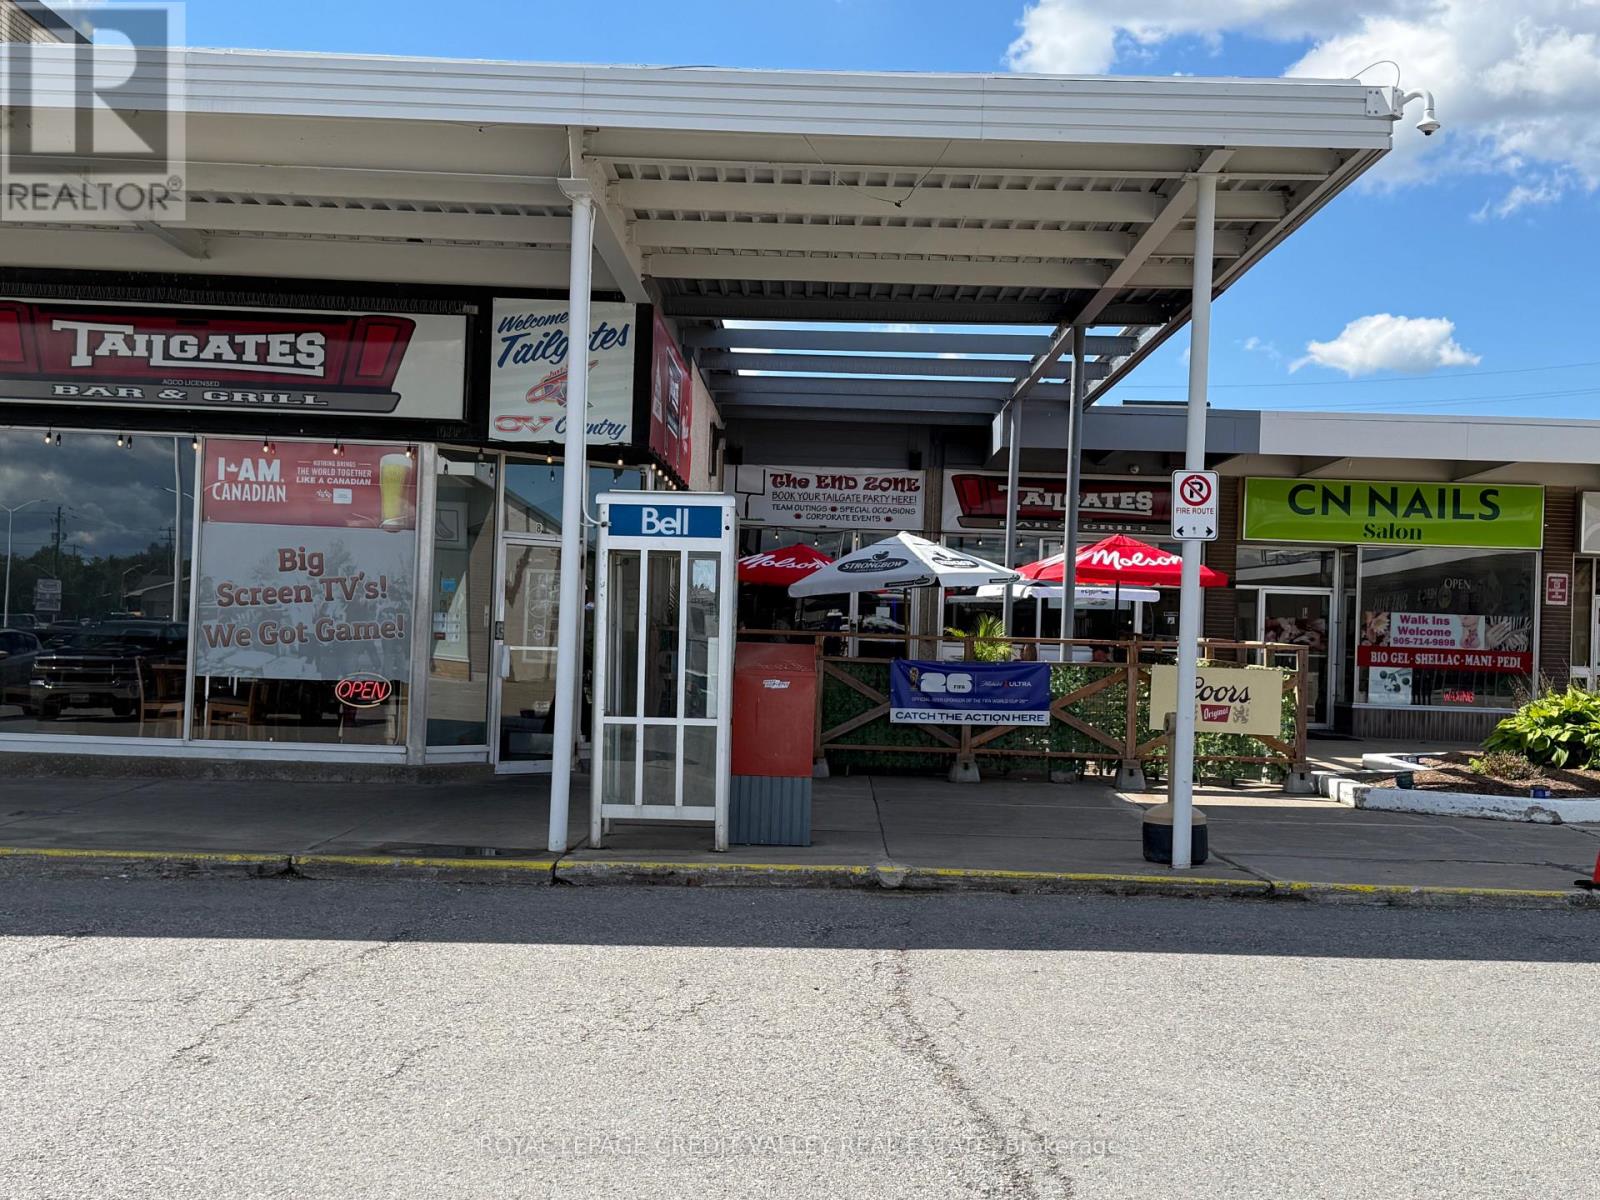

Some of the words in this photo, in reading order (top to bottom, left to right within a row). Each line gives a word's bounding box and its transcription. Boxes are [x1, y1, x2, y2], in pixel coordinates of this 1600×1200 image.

[497, 312, 569, 333] Welcome
[52, 319, 325, 377] TAILGATES
[497, 322, 630, 368] Tailgtes
[52, 384, 144, 399] BAR
[158, 387, 188, 400] &
[203, 390, 328, 406] GRILL
[555, 415, 627, 440] Cntry
[296, 476, 316, 484] LIKE
[327, 477, 371, 486] CANADIAN
[297, 467, 310, 476] THE
[311, 467, 336, 476] WORLD
[338, 468, 372, 477] TOGETHER
[816, 474, 858, 491] END
[863, 475, 921, 492] ZONE
[212, 482, 287, 503] CANADIAN
[772, 492, 797, 501] BOOK
[798, 493, 823, 501] YOUR
[823, 493, 862, 502] TAILGATE
[863, 495, 891, 503] PARTY
[892, 496, 917, 504] HERE!
[872, 507, 916, 515] OCCASIONS
[1287, 484, 1350, 516] CN
[1368, 485, 1501, 521] NAILS
[641, 507, 689, 535] Bell
[805, 513, 850, 521] CORPORATE
[1083, 523, 1153, 532] GRILL
[1363, 523, 1422, 540] Salon
[278, 547, 325, 576] Big
[842, 561, 902, 570] STRONGBOW
[217, 582, 313, 607] Screen
[319, 571, 387, 602] TV's!
[1444, 578, 1471, 590] OPEN
[1400, 615, 1429, 625] Walk
[1432, 615, 1450, 626] Ins
[203, 623, 251, 648] We
[259, 620, 309, 645] Got
[315, 614, 404, 642] Game!
[1397, 626, 1452, 637] Welcome
[1371, 651, 1388, 663] BIO
[1498, 657, 1521, 669] PEDI
[340, 681, 386, 699] OPEN
[895, 711, 936, 720] CATCH
[938, 712, 962, 721] THE
[964, 713, 1012, 722] ACTION
[1012, 714, 1045, 722] HERE
